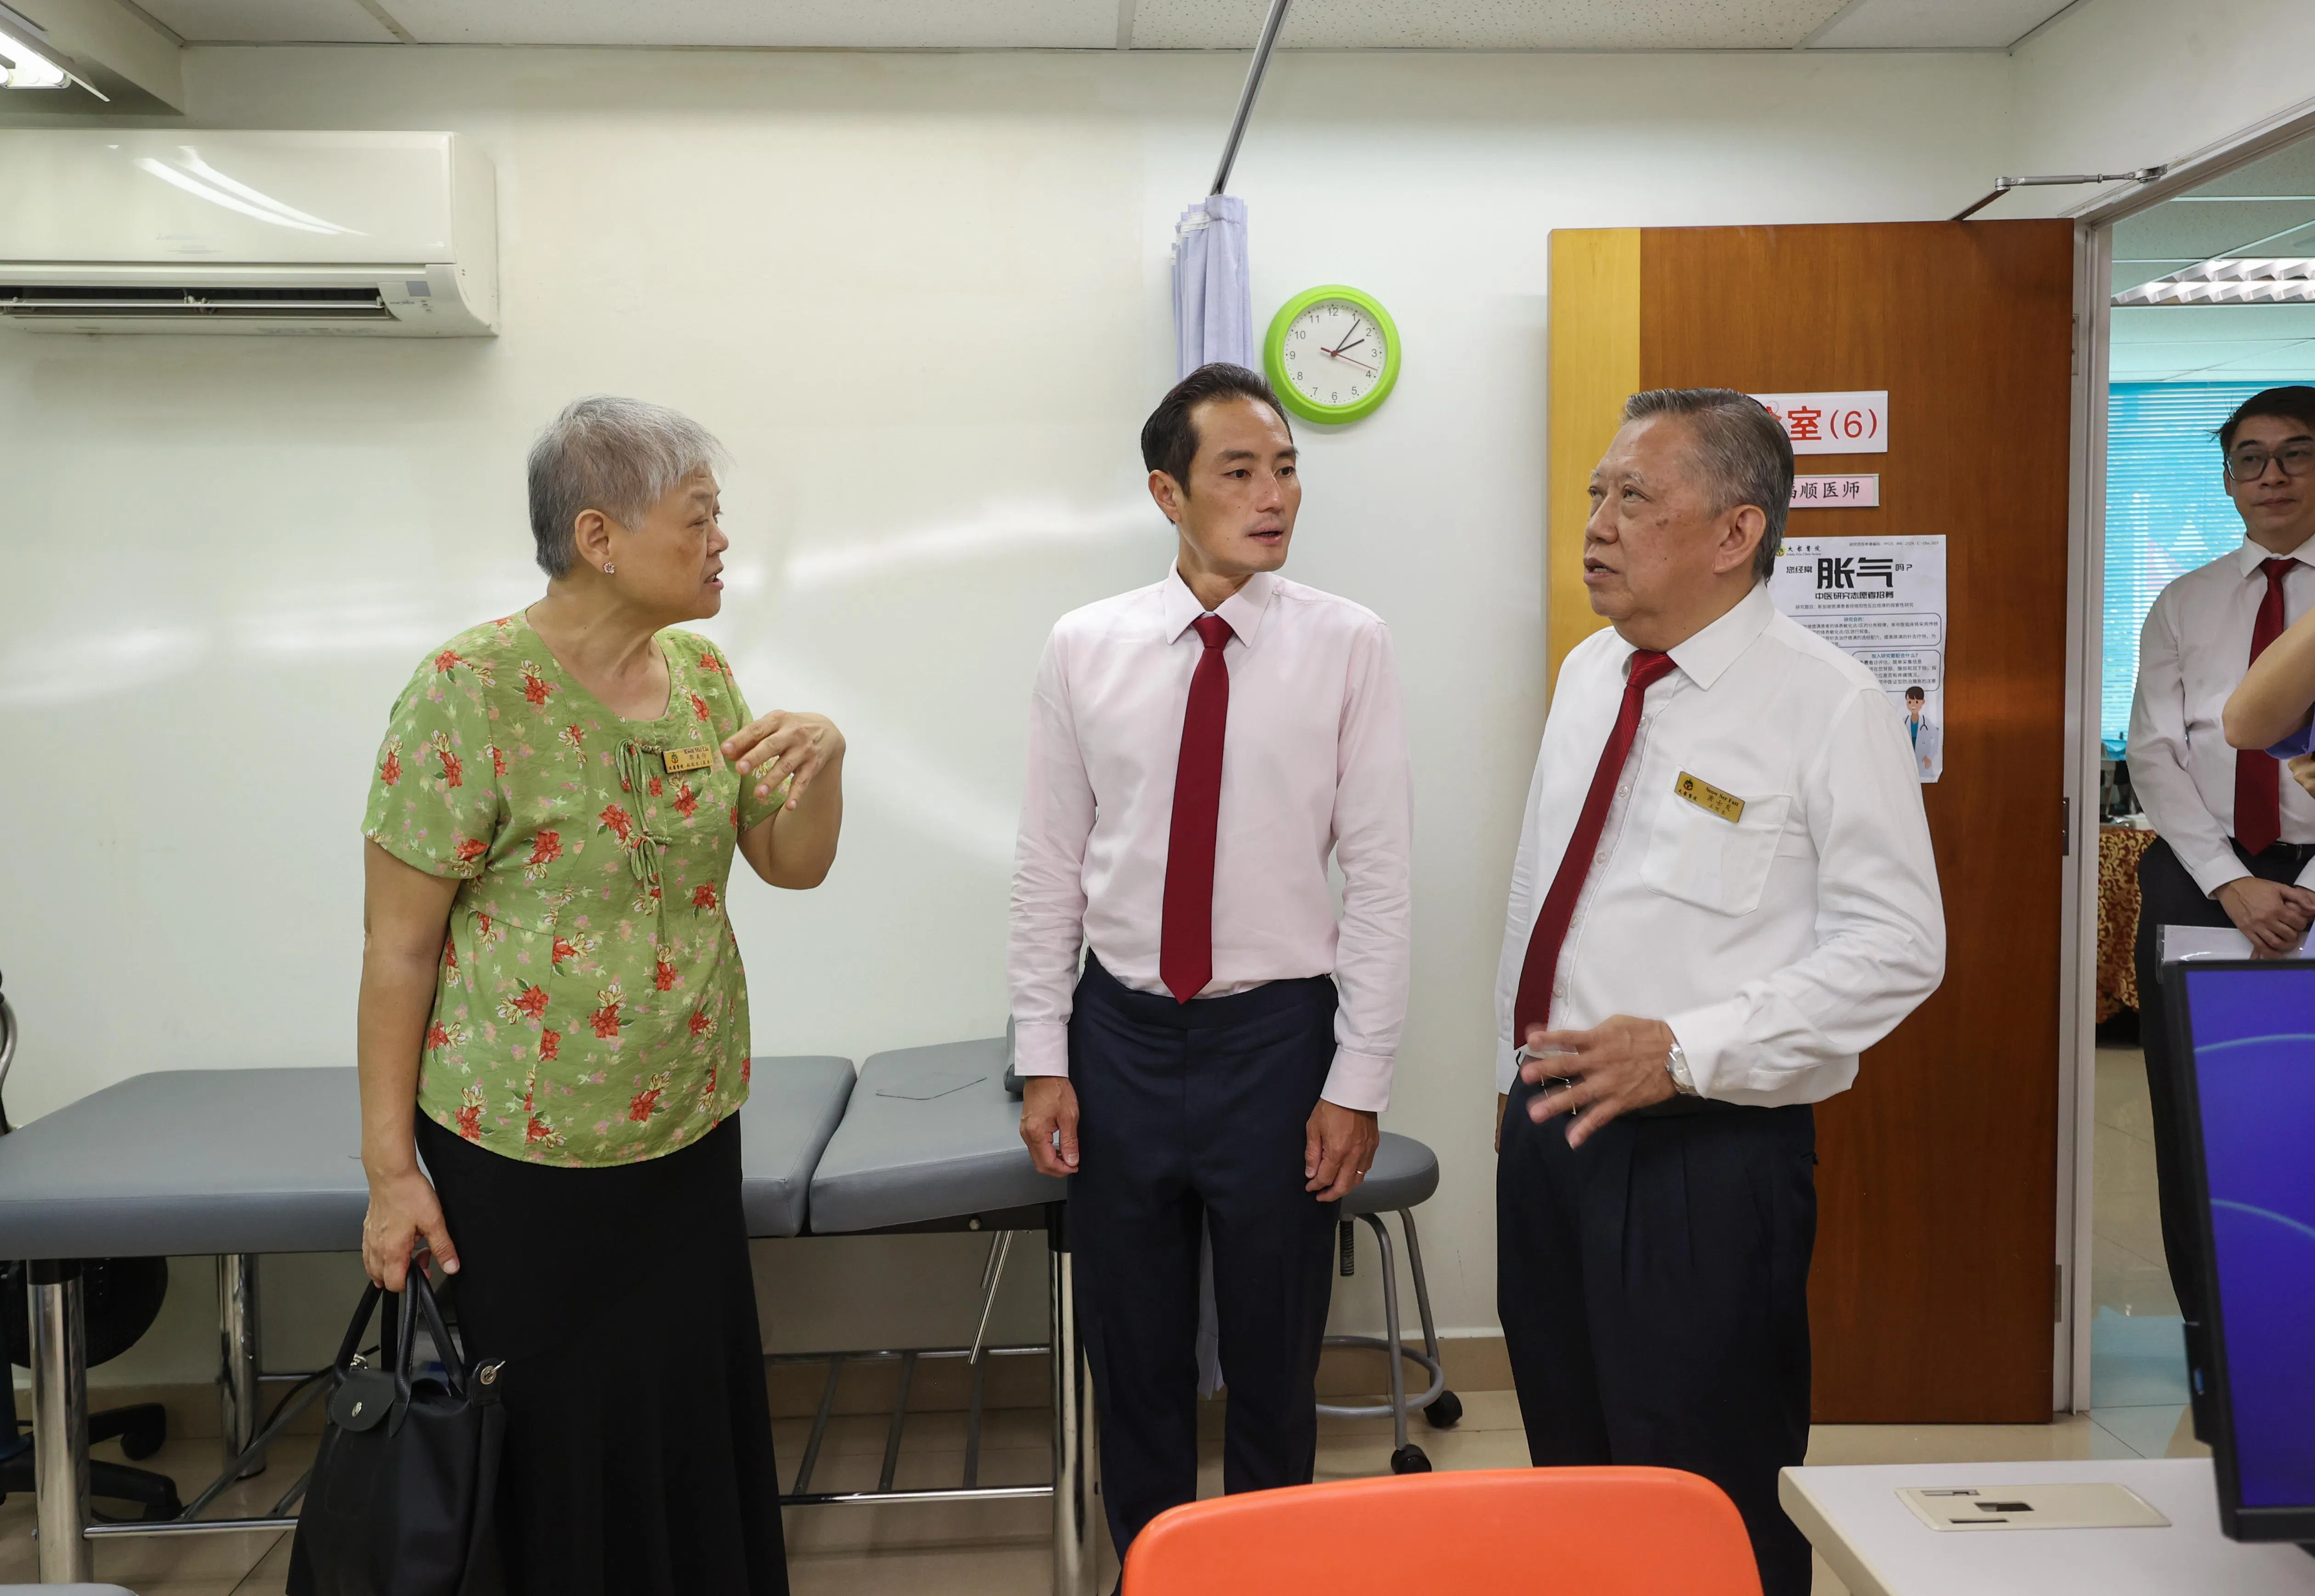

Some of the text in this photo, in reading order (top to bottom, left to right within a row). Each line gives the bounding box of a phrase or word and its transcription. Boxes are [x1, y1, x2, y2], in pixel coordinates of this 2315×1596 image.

[1327, 307, 1339, 316] 12
[1309, 315, 1320, 323] 11
[1295, 330, 1306, 339] 10
[1366, 328, 1372, 337] 2
[1290, 351, 1296, 359] 9
[1371, 349, 1377, 357] 3
[1297, 371, 1303, 380] 8
[1365, 370, 1371, 378] 4
[1312, 387, 1318, 395] 7
[1351, 386, 1357, 395] 5
[1331, 392, 1338, 400] 6
[1786, 565, 1812, 574] 您经常
[1817, 557, 1893, 589] 胀气
[1815, 591, 1894, 600] 中医研究志愿者招募
[1705, 786, 1718, 796] Seow
[1728, 798, 1739, 807] Fatt
